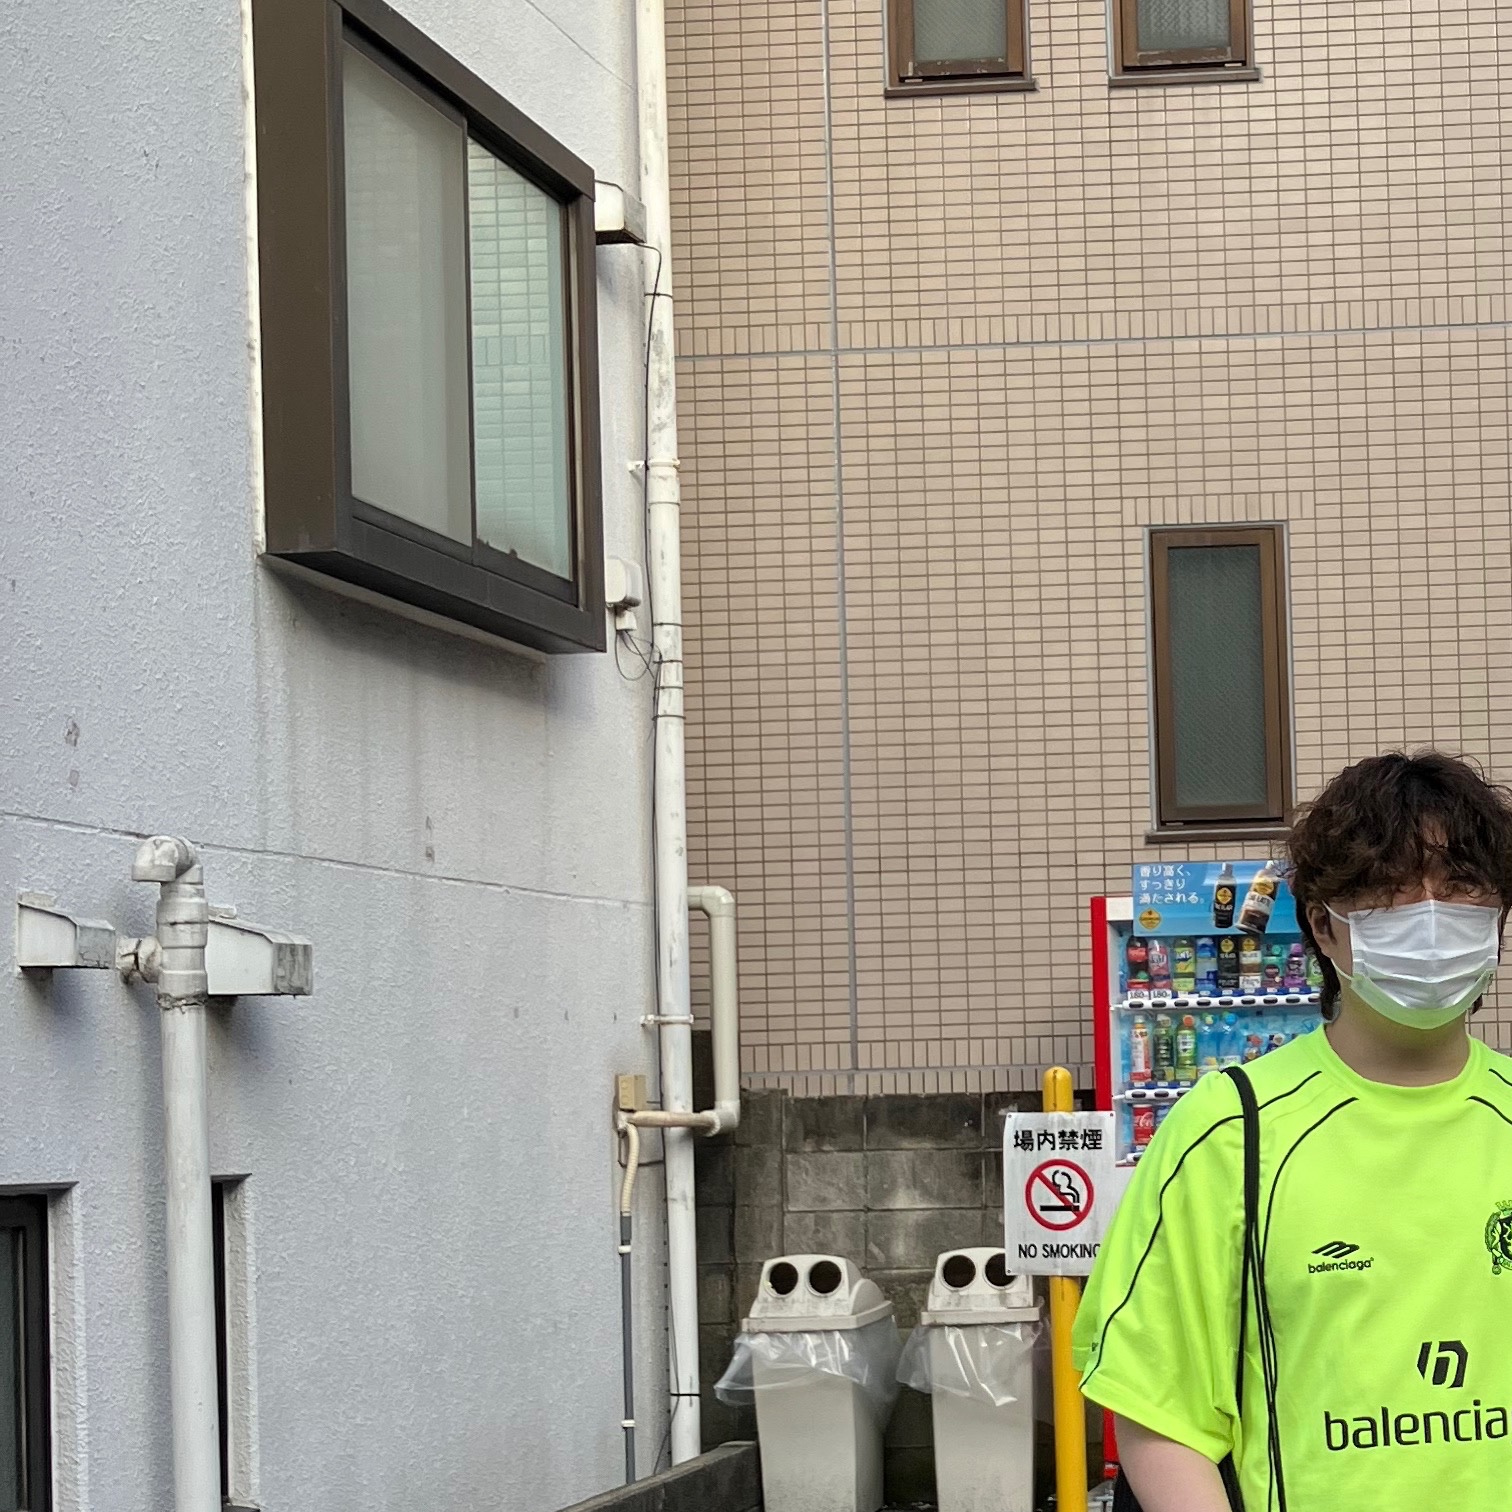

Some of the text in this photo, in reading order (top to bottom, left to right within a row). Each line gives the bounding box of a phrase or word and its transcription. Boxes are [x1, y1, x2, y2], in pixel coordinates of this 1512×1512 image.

[1139, 878, 1186, 890] すっきり
[1014, 1129, 1103, 1151] 場内禁煙
[1018, 1243, 1037, 1258] NO
[1308, 1258, 1372, 1274] balenciaga
